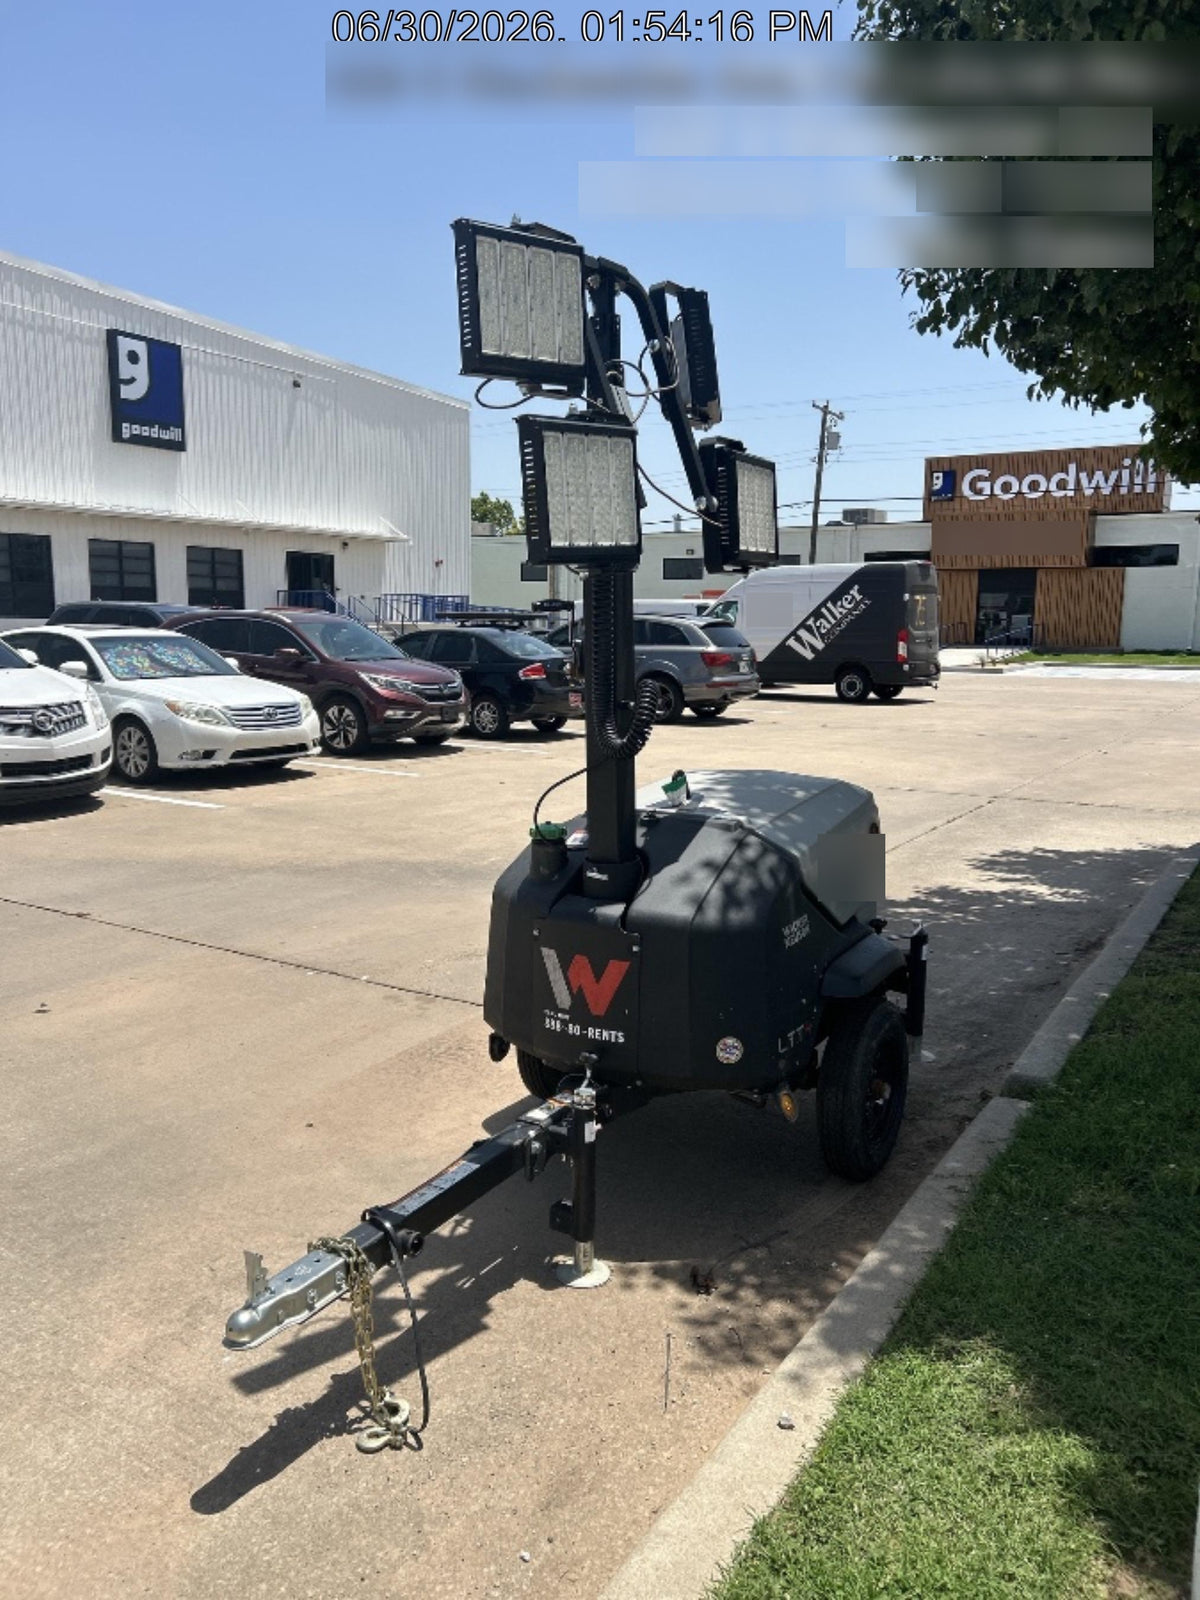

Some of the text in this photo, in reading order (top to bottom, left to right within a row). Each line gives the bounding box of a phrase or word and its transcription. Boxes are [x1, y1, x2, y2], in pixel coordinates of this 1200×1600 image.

[121, 422, 182, 442] goodwill
[961, 457, 1158, 500] Goodwill
[786, 584, 863, 660] Walker
